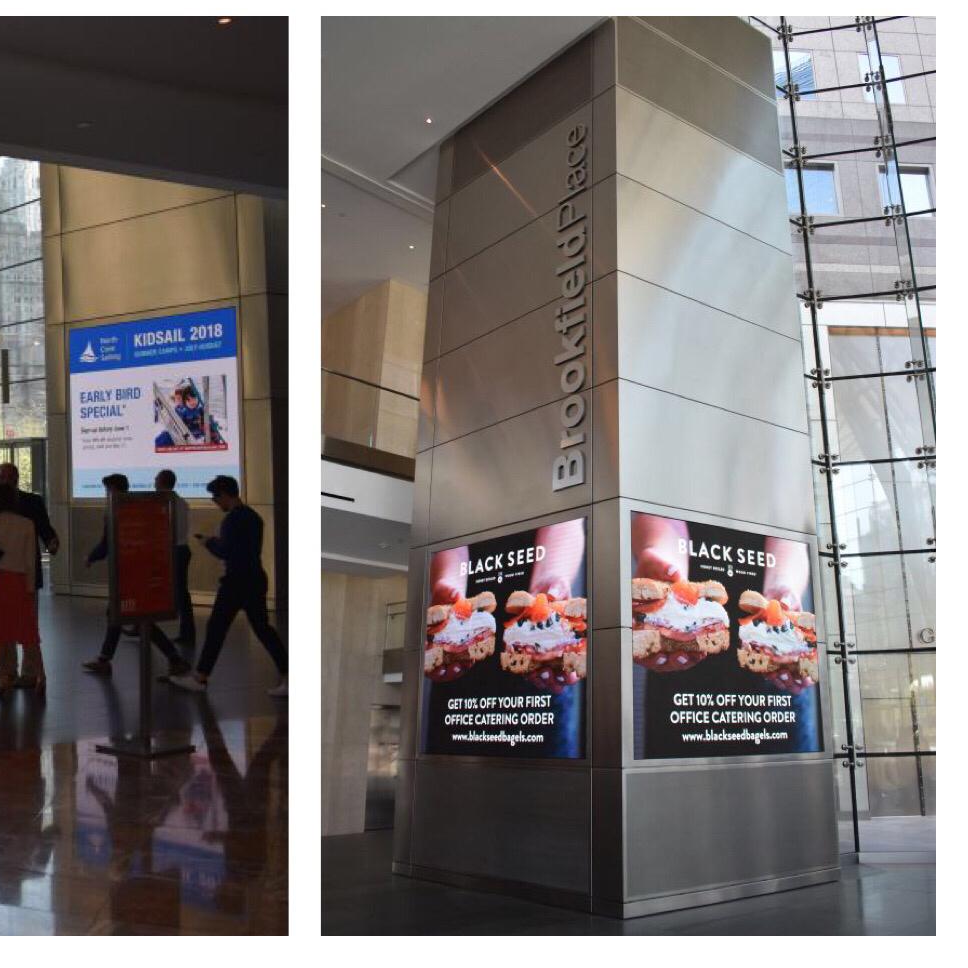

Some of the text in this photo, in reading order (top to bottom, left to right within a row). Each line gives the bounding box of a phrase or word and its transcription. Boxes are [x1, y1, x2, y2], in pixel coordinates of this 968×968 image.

[134, 323, 223, 347] KIDSAIL 2018
[80, 386, 141, 403] EARLY BIRD
[460, 545, 546, 576] BLACK SEED
[678, 538, 776, 568] BLACK SEED
[447, 695, 552, 709] GET 10% OFF YOUR FIRST
[673, 693, 792, 707] GET 10% OFF YOUR FIRST
[444, 712, 555, 725] OFFICE CATERING ORDER
[670, 711, 796, 724] OFFICE CATERING ORDER
[452, 730, 544, 747] www.blackseedbagels.com
[682, 728, 788, 745] www.blackseedbagels.com
